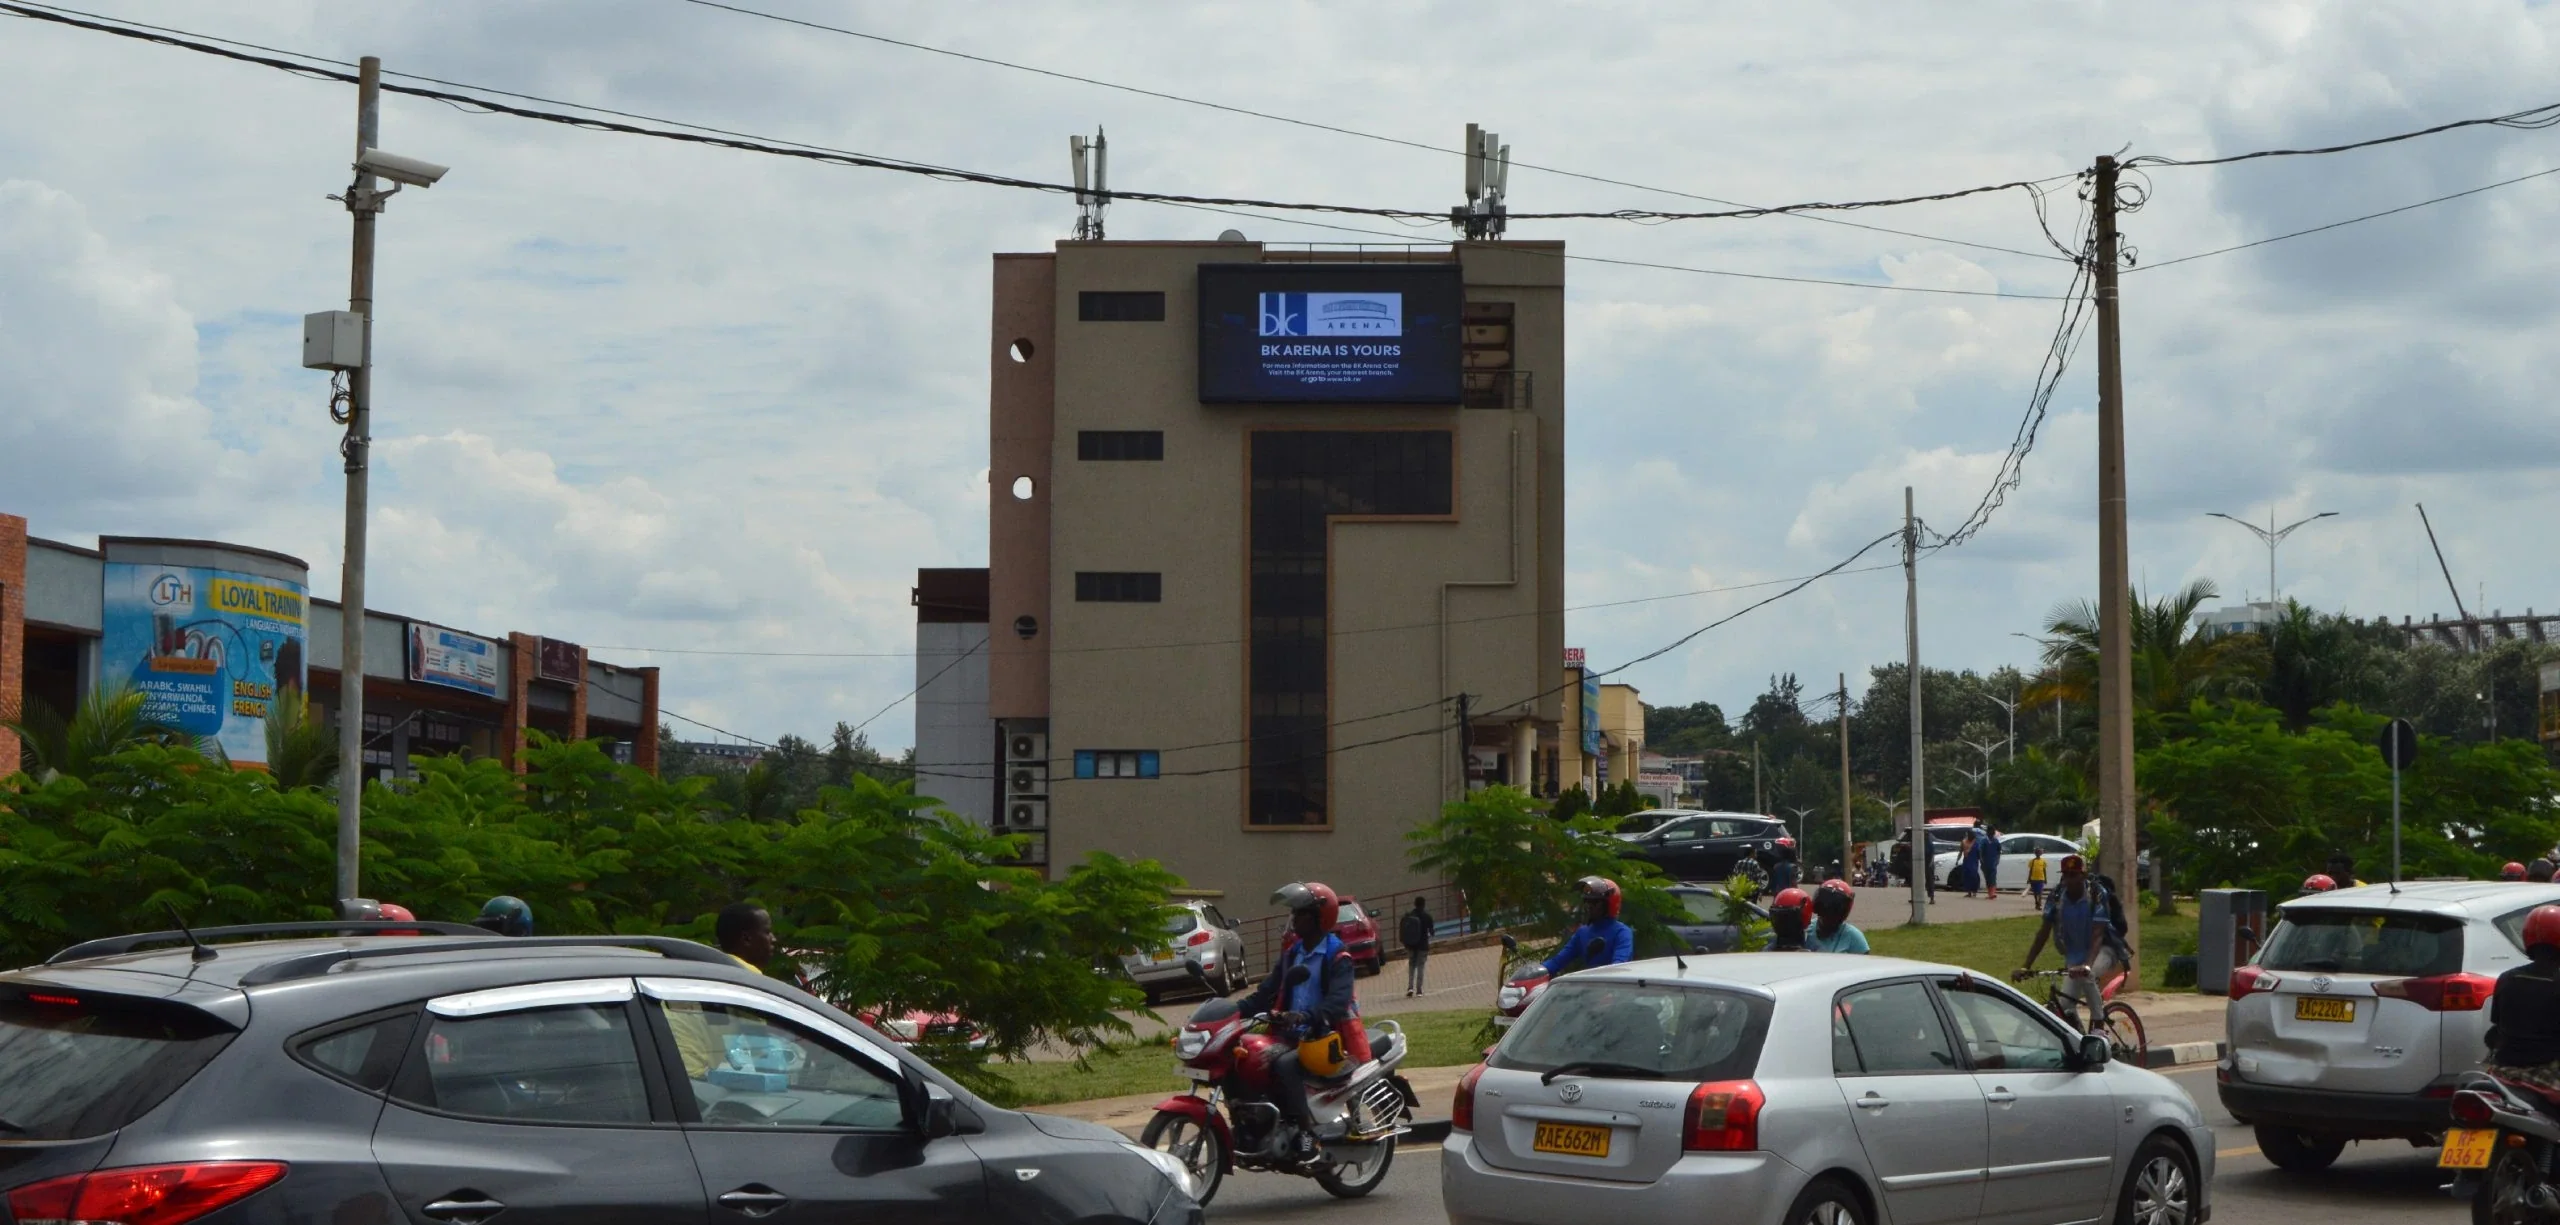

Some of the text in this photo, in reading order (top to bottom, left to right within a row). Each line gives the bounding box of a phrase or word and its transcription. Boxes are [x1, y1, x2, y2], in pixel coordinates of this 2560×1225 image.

[1261, 345, 1401, 356] BK ARENA IS YOURS
[160, 582, 191, 603] LTH
[221, 584, 262, 613] LOYAL
[140, 680, 176, 693] ARABIC,
[233, 680, 272, 700] ENGLISH
[233, 700, 267, 718] FRENCH
[2299, 1000, 2346, 1019] RAC220X
[1535, 1126, 1602, 1151] RAE662M
[2458, 1130, 2480, 1147] RF
[2474, 1148, 2486, 1166] Z
